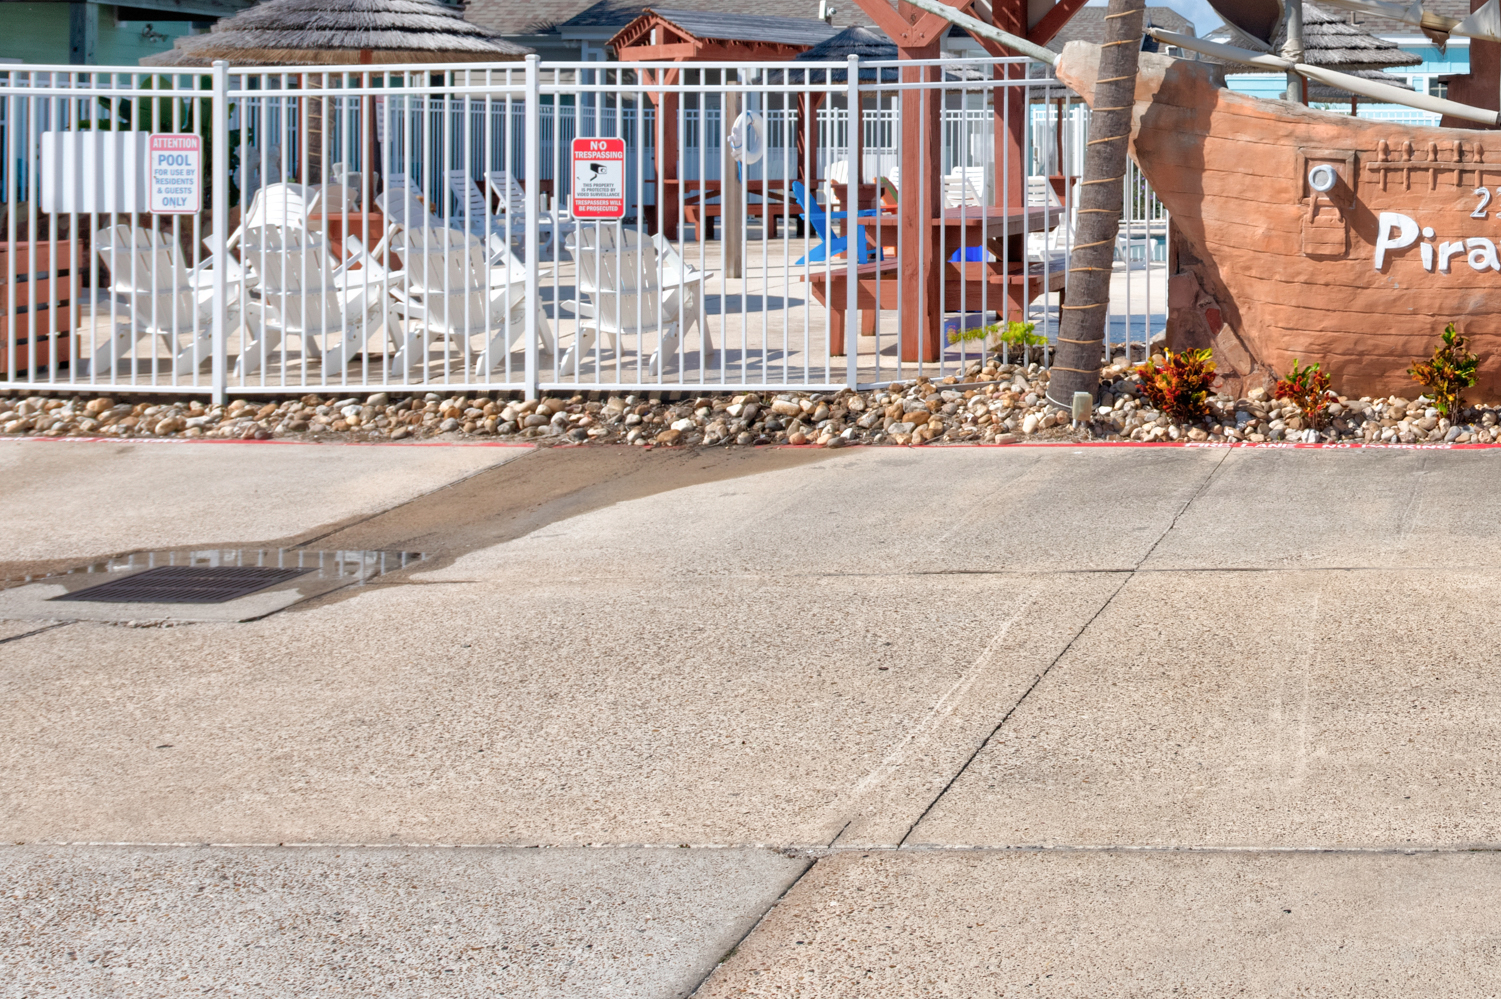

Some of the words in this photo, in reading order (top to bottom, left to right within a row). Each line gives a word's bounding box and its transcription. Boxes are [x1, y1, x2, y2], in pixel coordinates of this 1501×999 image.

[153, 137, 197, 148] ATTENTION
[590, 141, 607, 150] NO
[158, 154, 191, 166] POOL
[162, 197, 187, 207] ONLY
